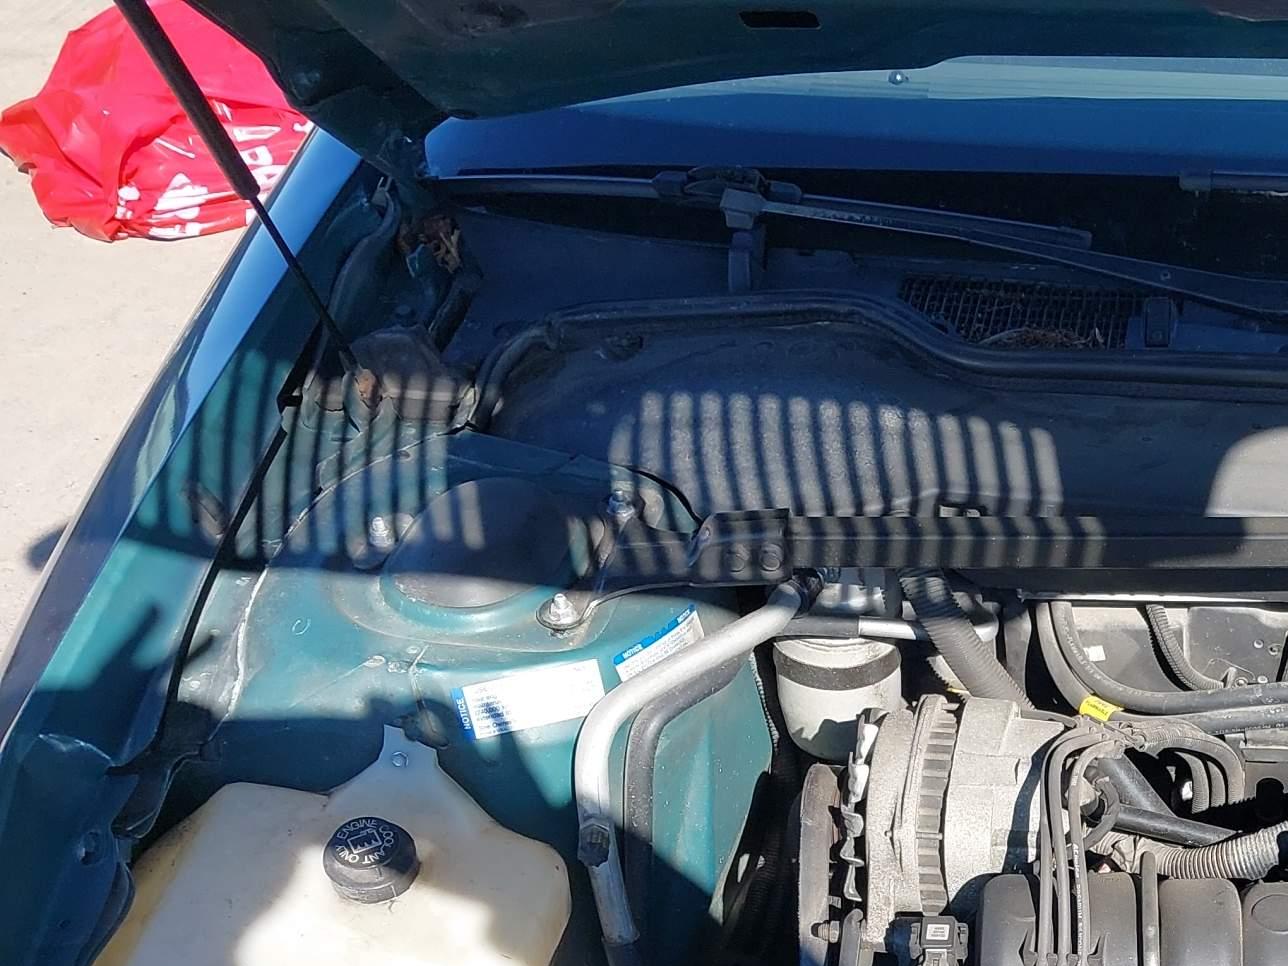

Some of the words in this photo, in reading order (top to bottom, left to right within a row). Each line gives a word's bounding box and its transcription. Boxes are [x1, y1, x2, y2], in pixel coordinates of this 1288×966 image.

[455, 698, 472, 730] NOTICE
[337, 819, 378, 840] ENGINE
[335, 844, 360, 864] ONLY
[361, 824, 394, 865] COOLANT
